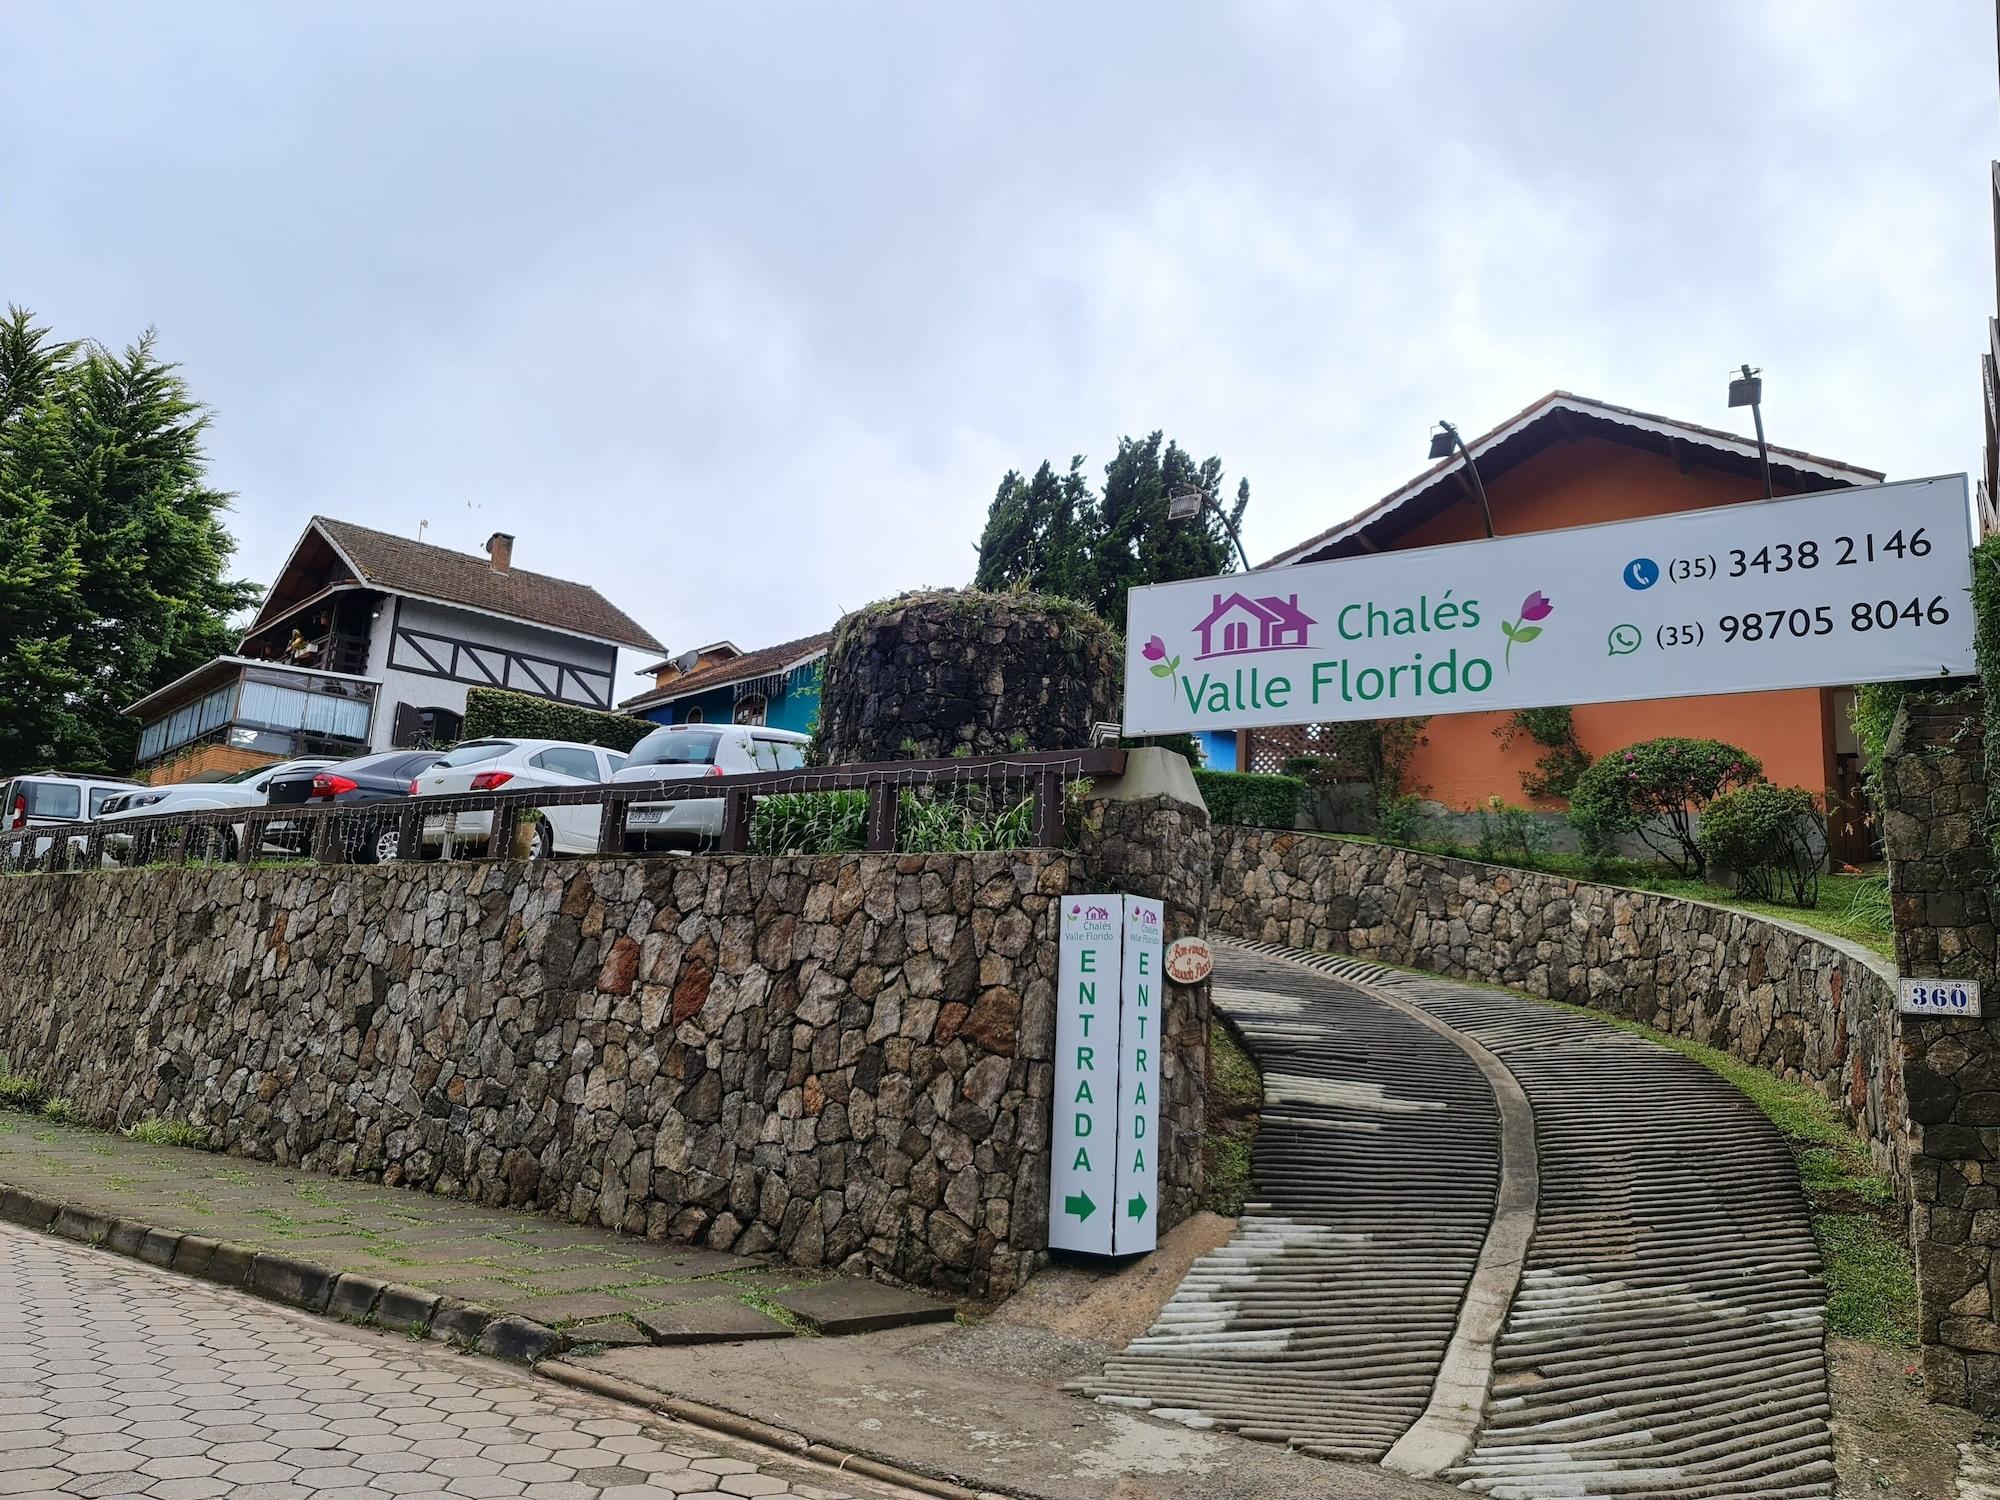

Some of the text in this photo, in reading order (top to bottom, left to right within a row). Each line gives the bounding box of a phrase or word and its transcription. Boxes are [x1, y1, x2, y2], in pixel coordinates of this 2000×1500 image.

[1669, 528, 1932, 584] (35) 3438 2146
[1337, 590, 1481, 641] Chalés
[1656, 596, 1950, 650] (35) 98705 8046
[1182, 648, 1493, 714] Valle Florido
[1065, 931, 1114, 941] Valle Florido
[1912, 987, 1967, 1008] 360
[1072, 949, 1096, 1172] ENTRADA
[1133, 952, 1149, 1173] ENTRADA
